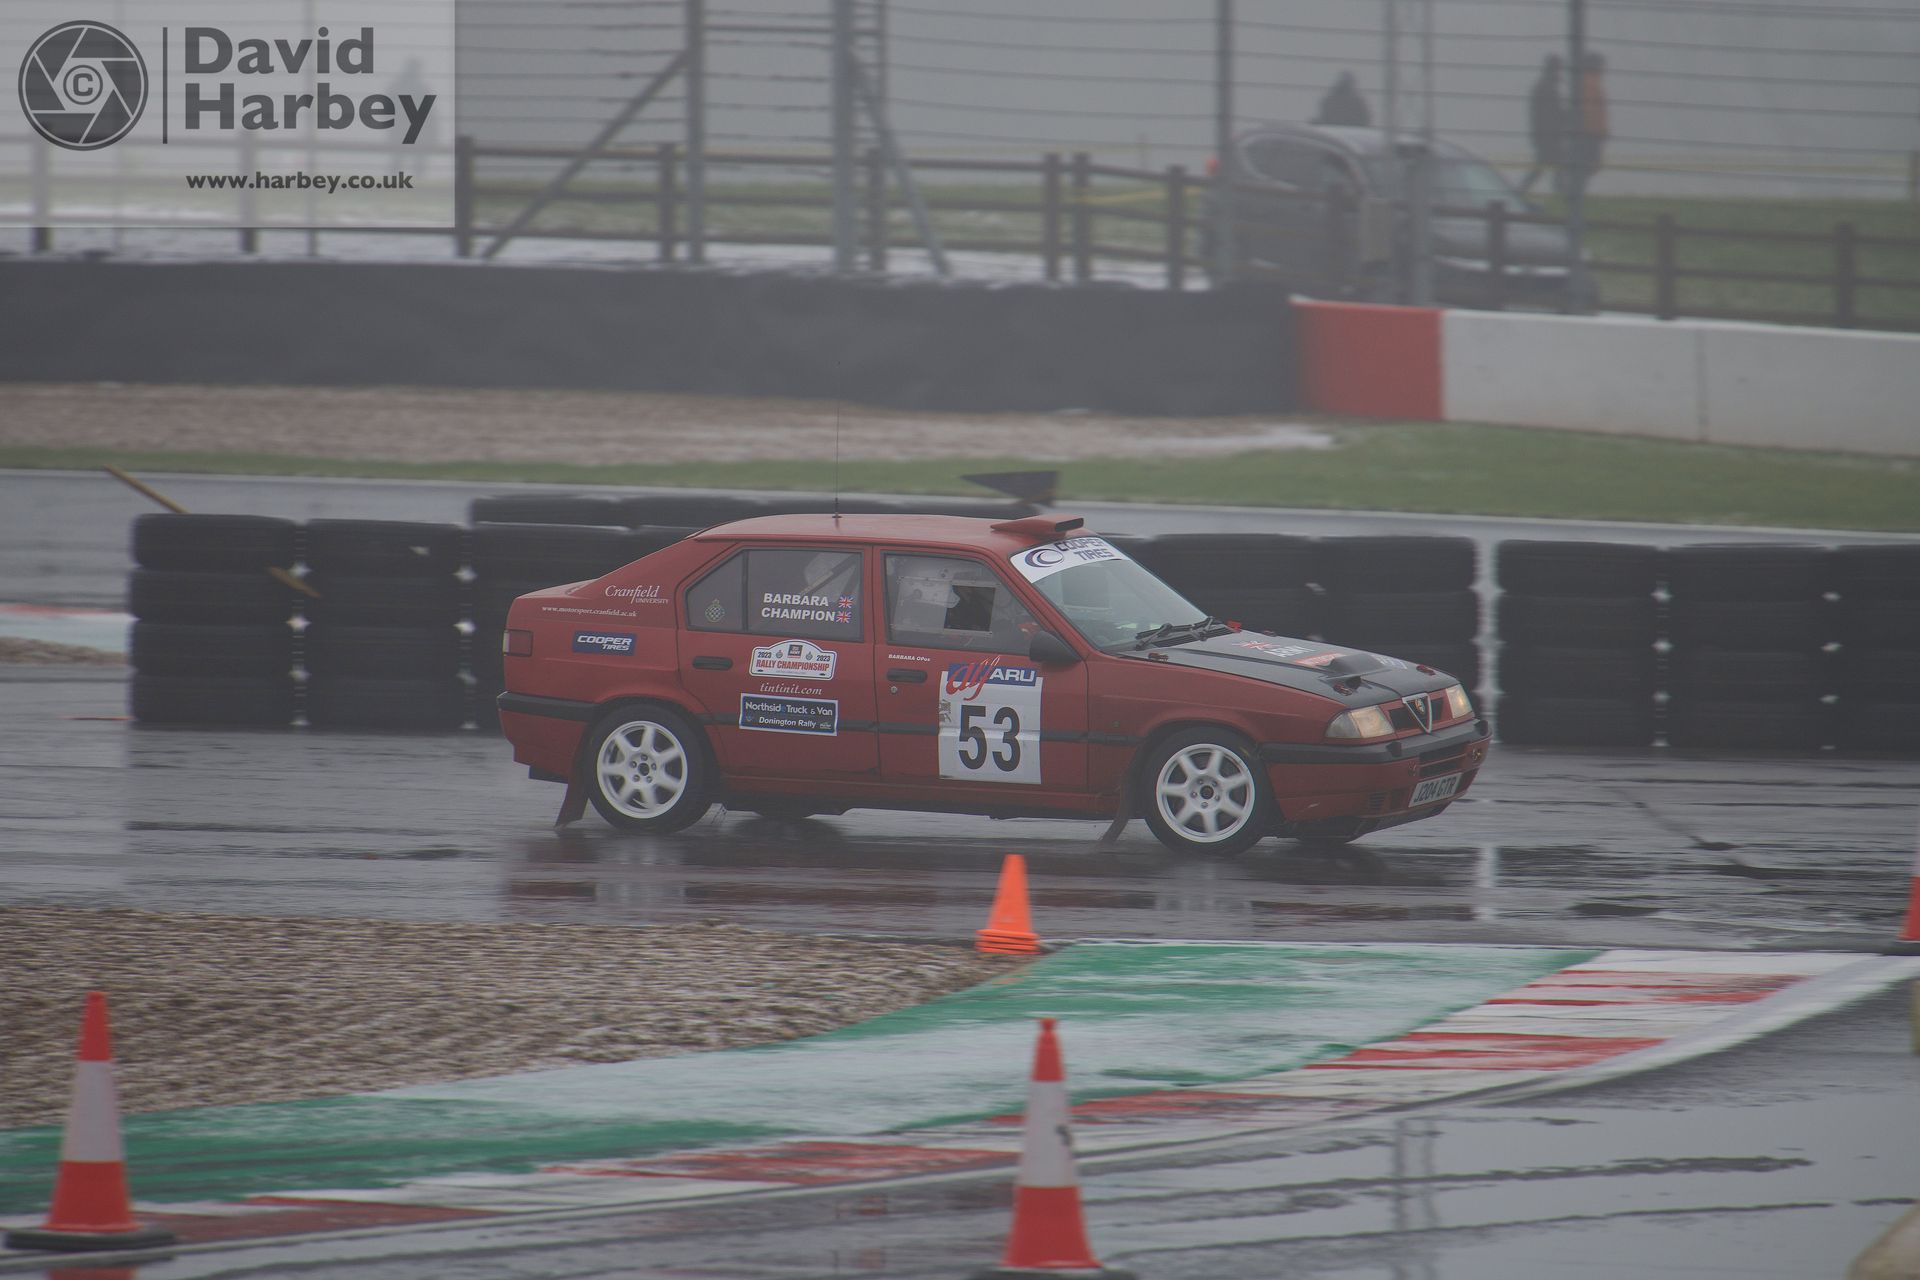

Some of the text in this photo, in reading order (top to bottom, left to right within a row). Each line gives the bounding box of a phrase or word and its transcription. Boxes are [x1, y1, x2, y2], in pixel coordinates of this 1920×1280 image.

[1073, 548, 1116, 561] TIRES
[605, 585, 660, 604] Cranfield
[763, 593, 829, 606] BARBARA
[761, 607, 836, 622] CHAMPION
[577, 635, 632, 645] COOPER
[756, 659, 830, 671] RALLY CHAMPIONSHIP
[760, 682, 822, 695] tintinit.com
[786, 704, 808, 714] Truck
[817, 706, 833, 716] Van
[759, 716, 796, 727] Donington
[798, 719, 816, 729] Rally
[958, 704, 1021, 772] 53
